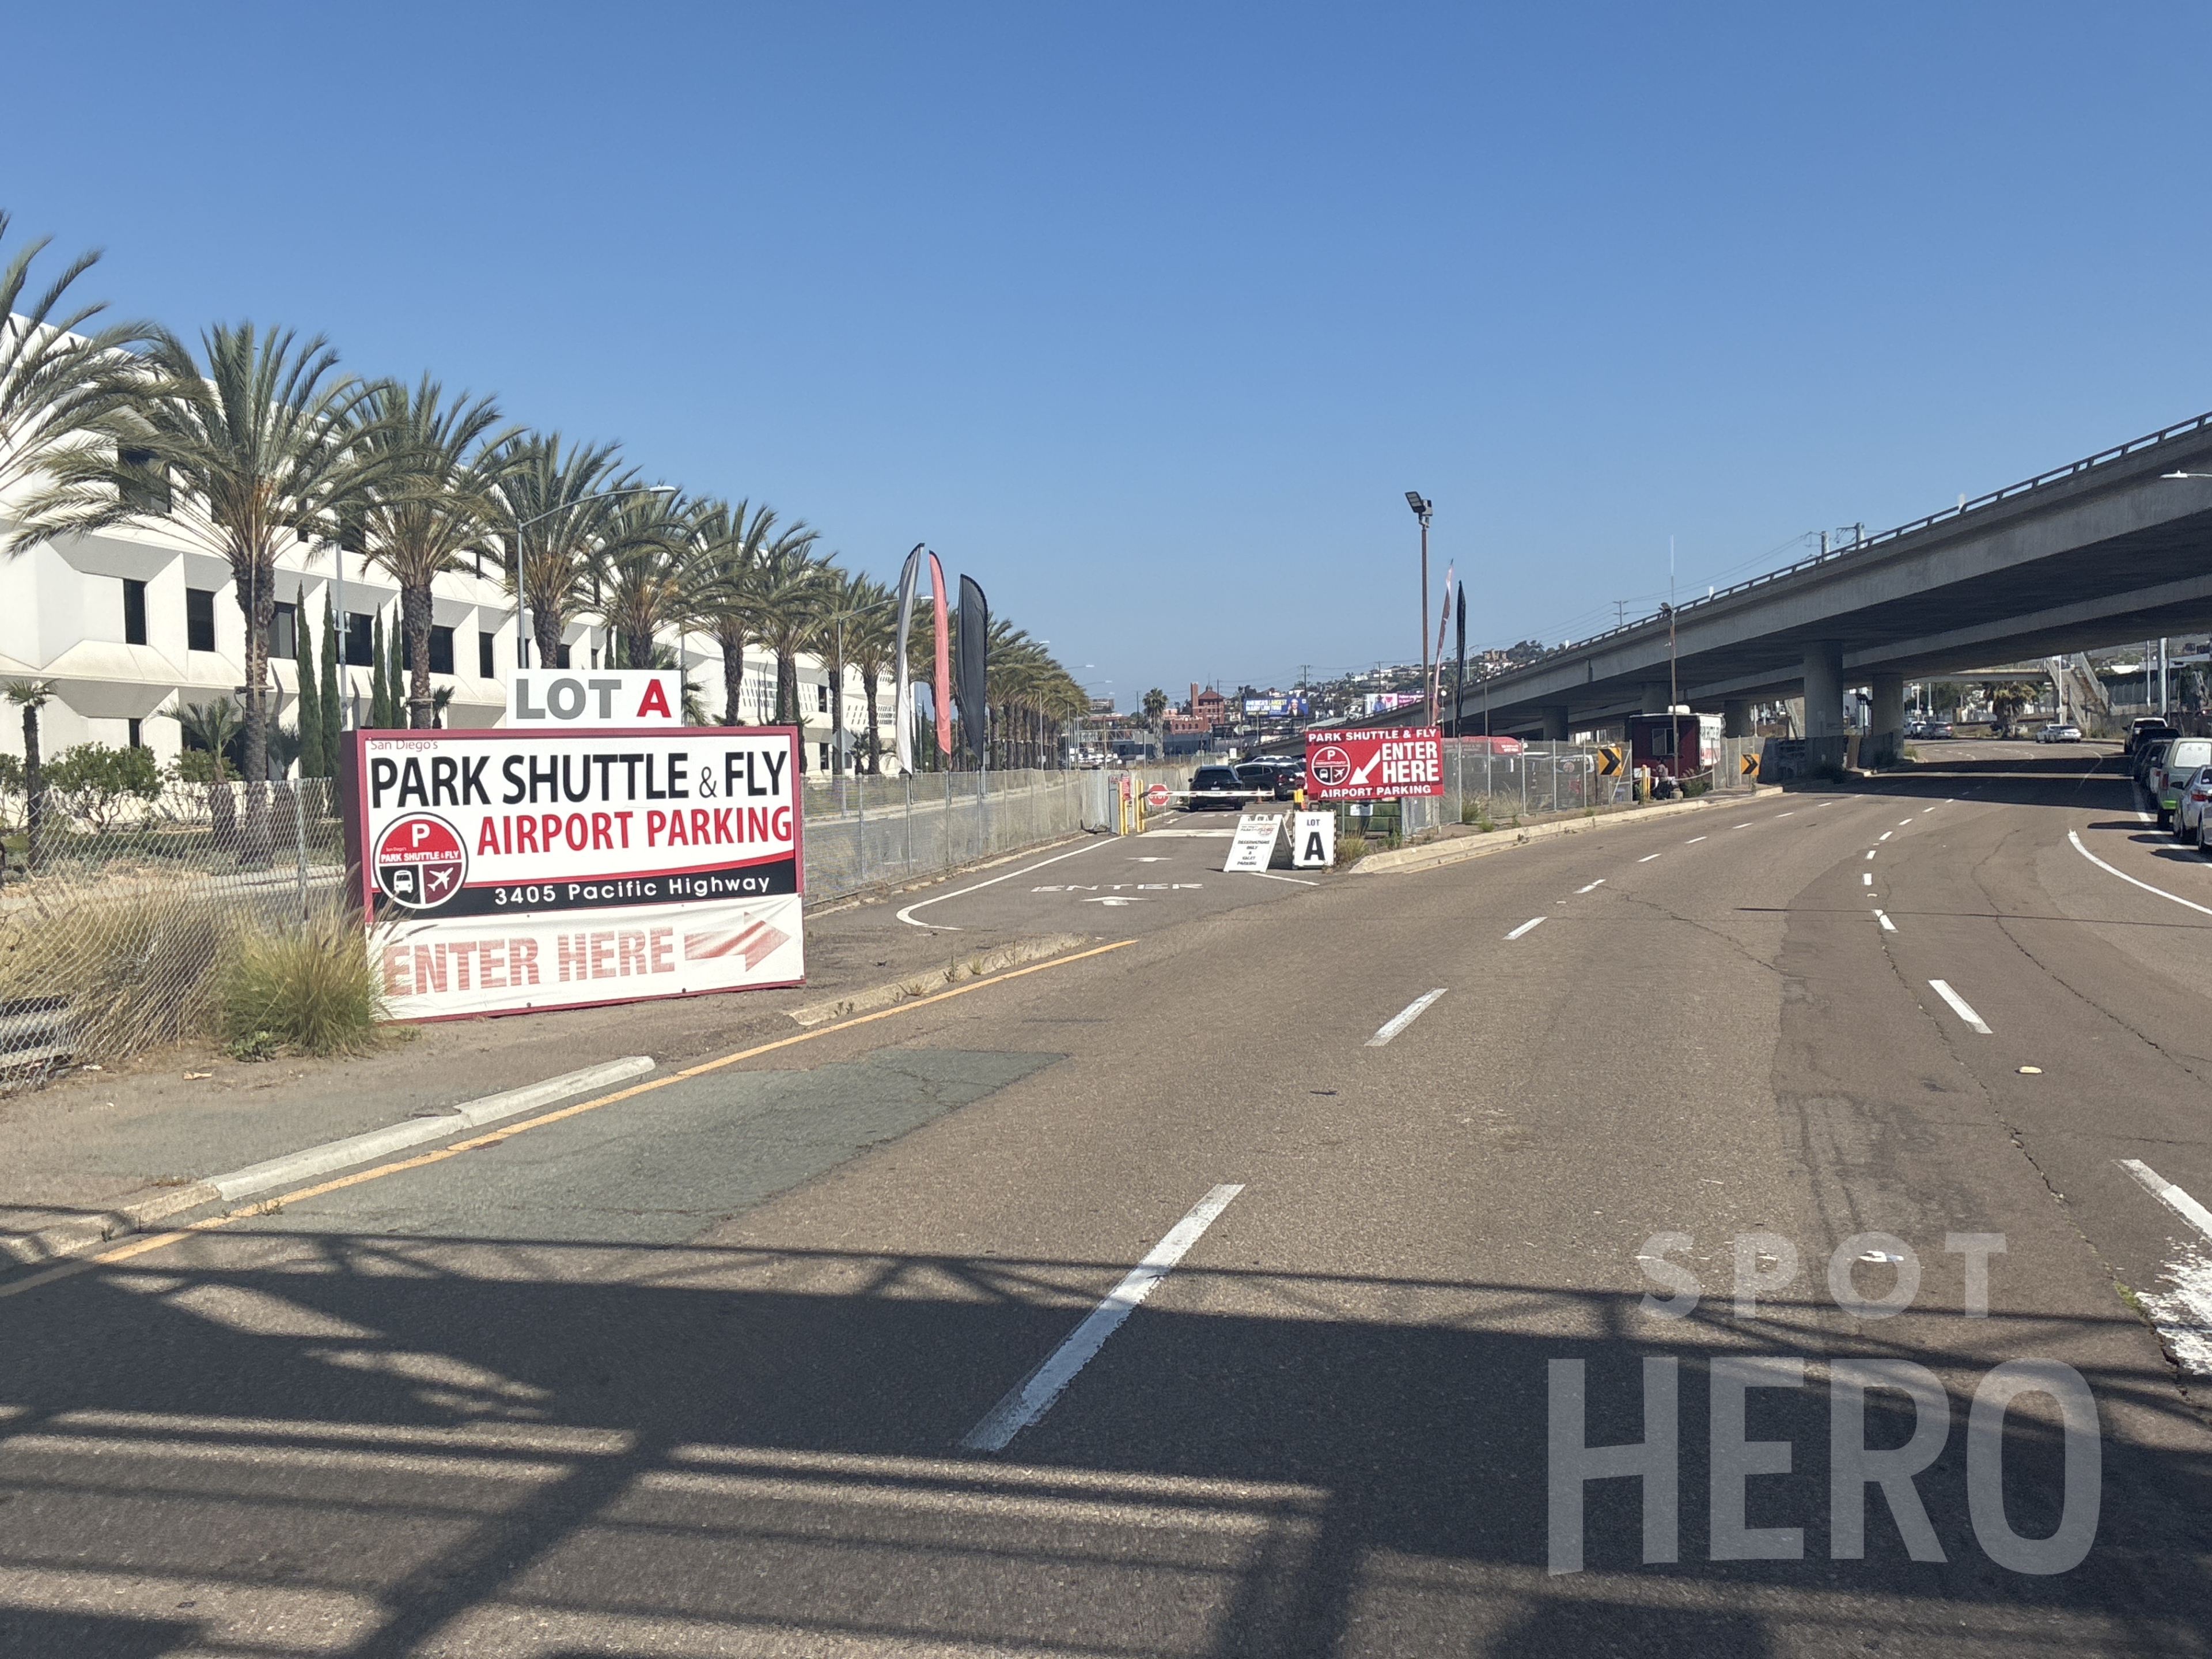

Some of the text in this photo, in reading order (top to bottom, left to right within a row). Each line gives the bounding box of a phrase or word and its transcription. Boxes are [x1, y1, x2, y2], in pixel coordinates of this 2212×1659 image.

[515, 678, 672, 720] LOT A
[370, 740, 438, 752] San Diego's
[1308, 728, 1437, 743] PARK SHUTTLE & FLY
[1327, 749, 1336, 760] P
[1382, 741, 1438, 761] ENTER
[371, 751, 787, 809] PARK SHUTTLE & FLY
[1382, 759, 1440, 784] HERE
[1320, 785, 1431, 798] AIRPORT PARKING
[411, 823, 430, 849] P
[478, 805, 792, 855] AIRPORT PARKING
[381, 853, 402, 863] PARK
[403, 851, 440, 862] SHUTTLE
[444, 850, 459, 859] FLY
[1304, 831, 1325, 861] A
[494, 875, 771, 906] 3405 Pacific Highway
[1030, 883, 1204, 892] ENTER
[383, 926, 675, 997] ENTER HERE
